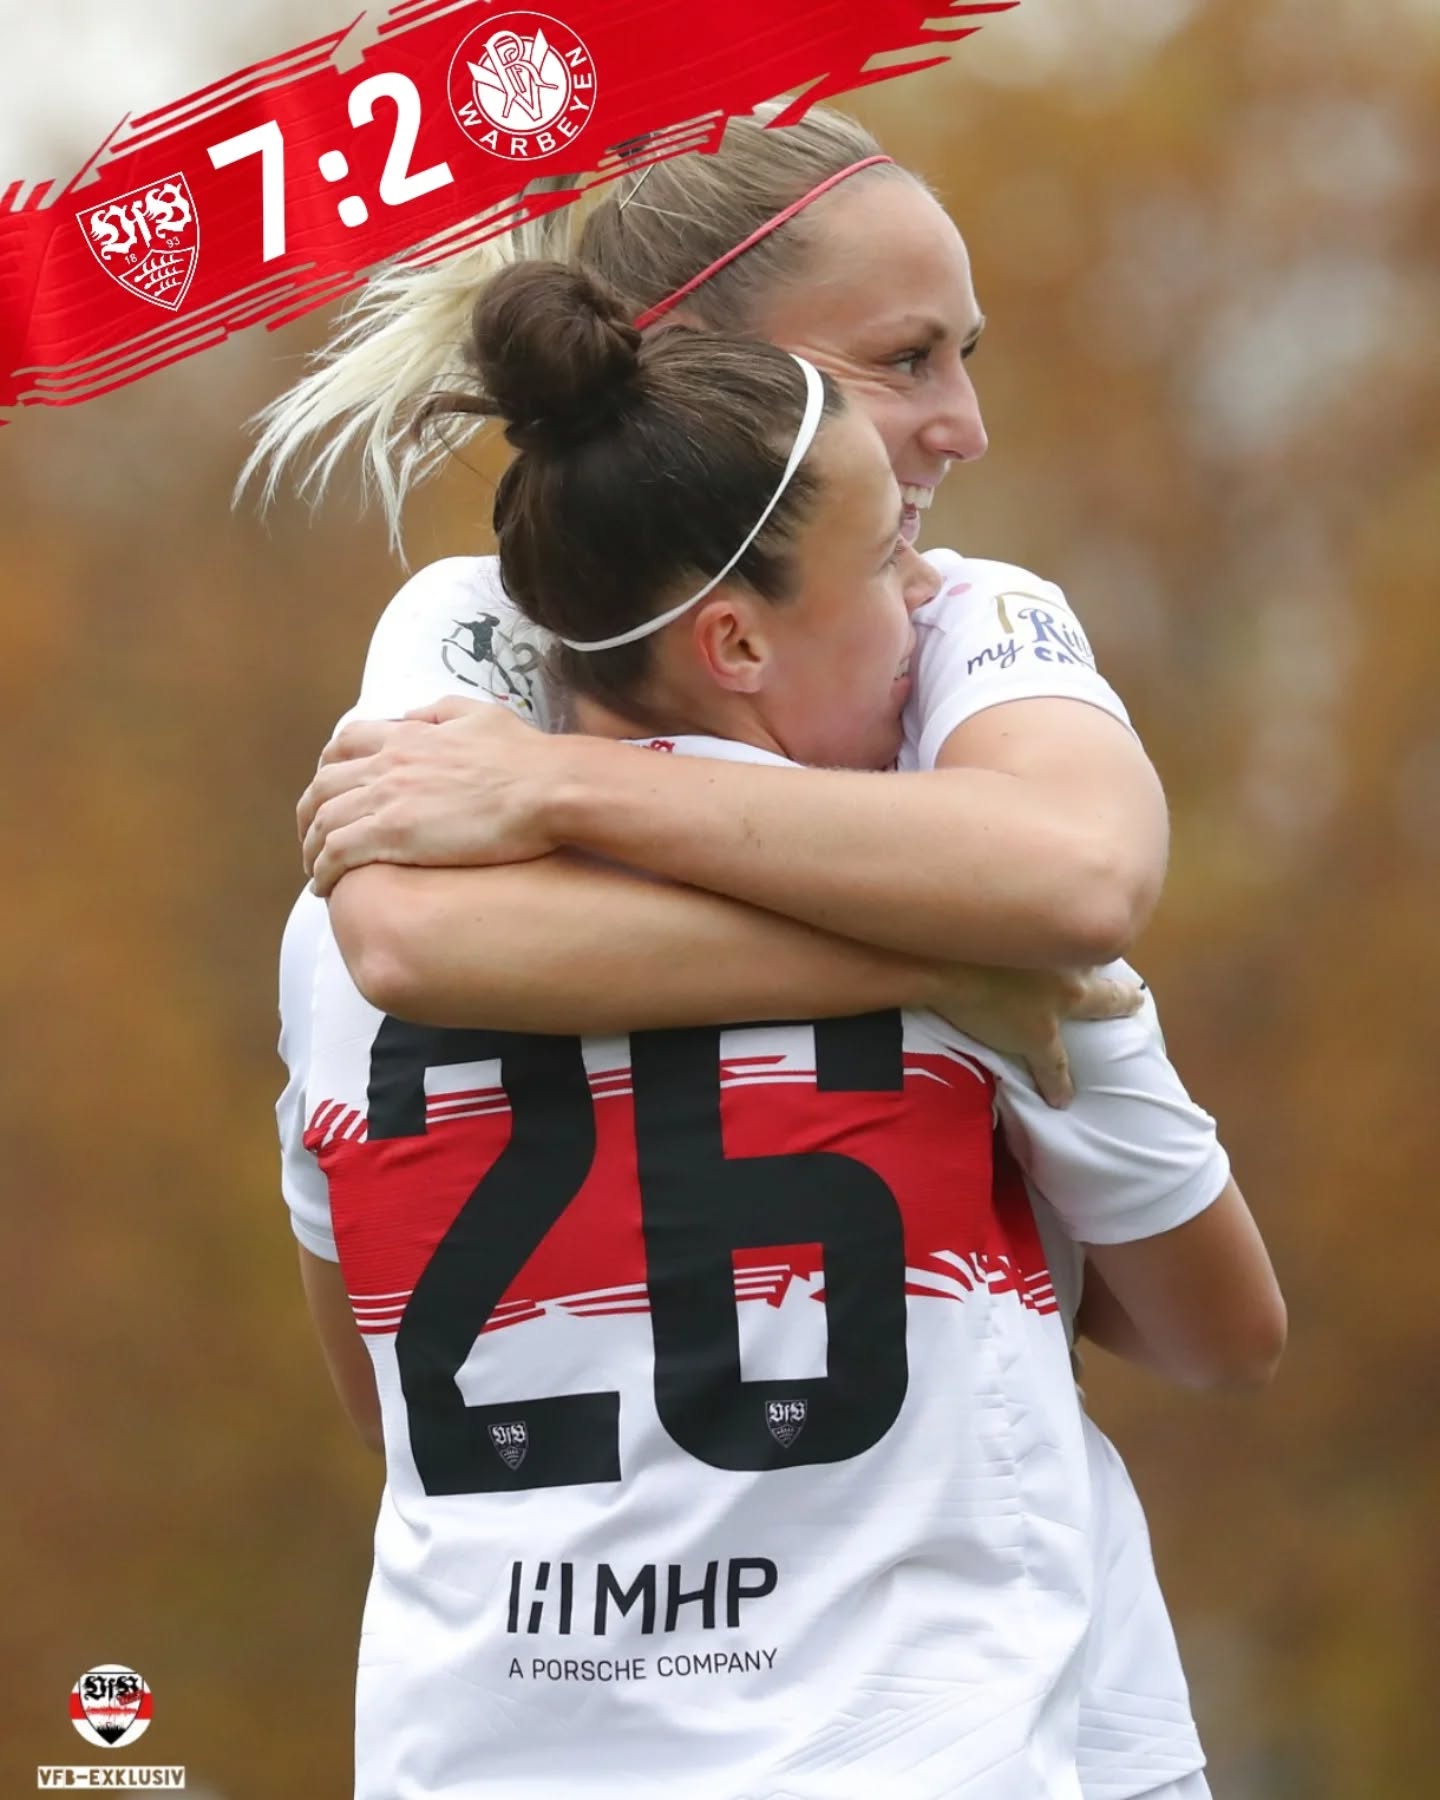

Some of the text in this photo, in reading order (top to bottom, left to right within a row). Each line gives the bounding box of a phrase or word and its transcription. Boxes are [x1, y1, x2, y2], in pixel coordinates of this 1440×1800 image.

[966, 639, 1024, 675] my
[366, 1006, 909, 1497] 26
[593, 1557, 778, 1636] MHP
[508, 1647, 778, 1682] A PORSCHE COMPANY
